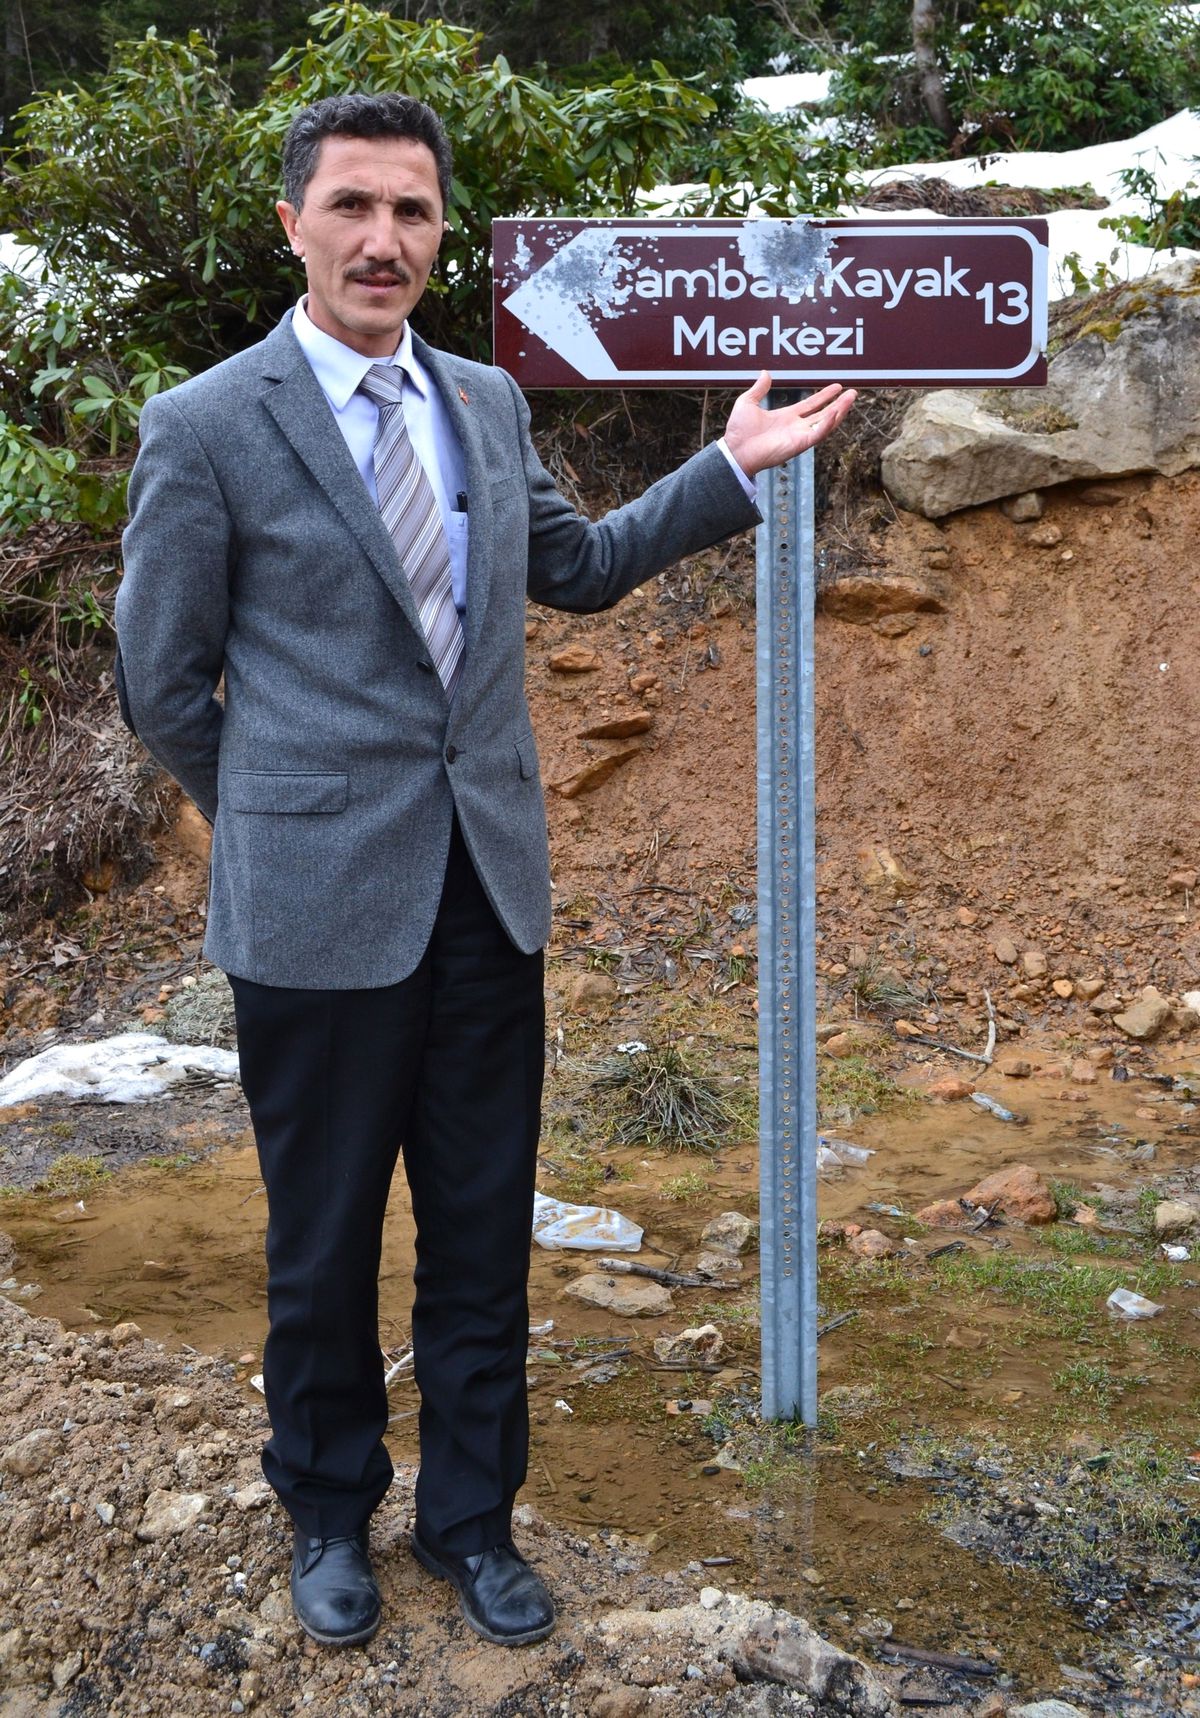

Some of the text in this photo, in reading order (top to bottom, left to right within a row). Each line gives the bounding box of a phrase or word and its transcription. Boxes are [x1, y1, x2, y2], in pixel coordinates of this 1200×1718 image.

[824, 256, 971, 309] Kayak
[975, 282, 1030, 325] 13
[673, 315, 864, 356] Merkezi
